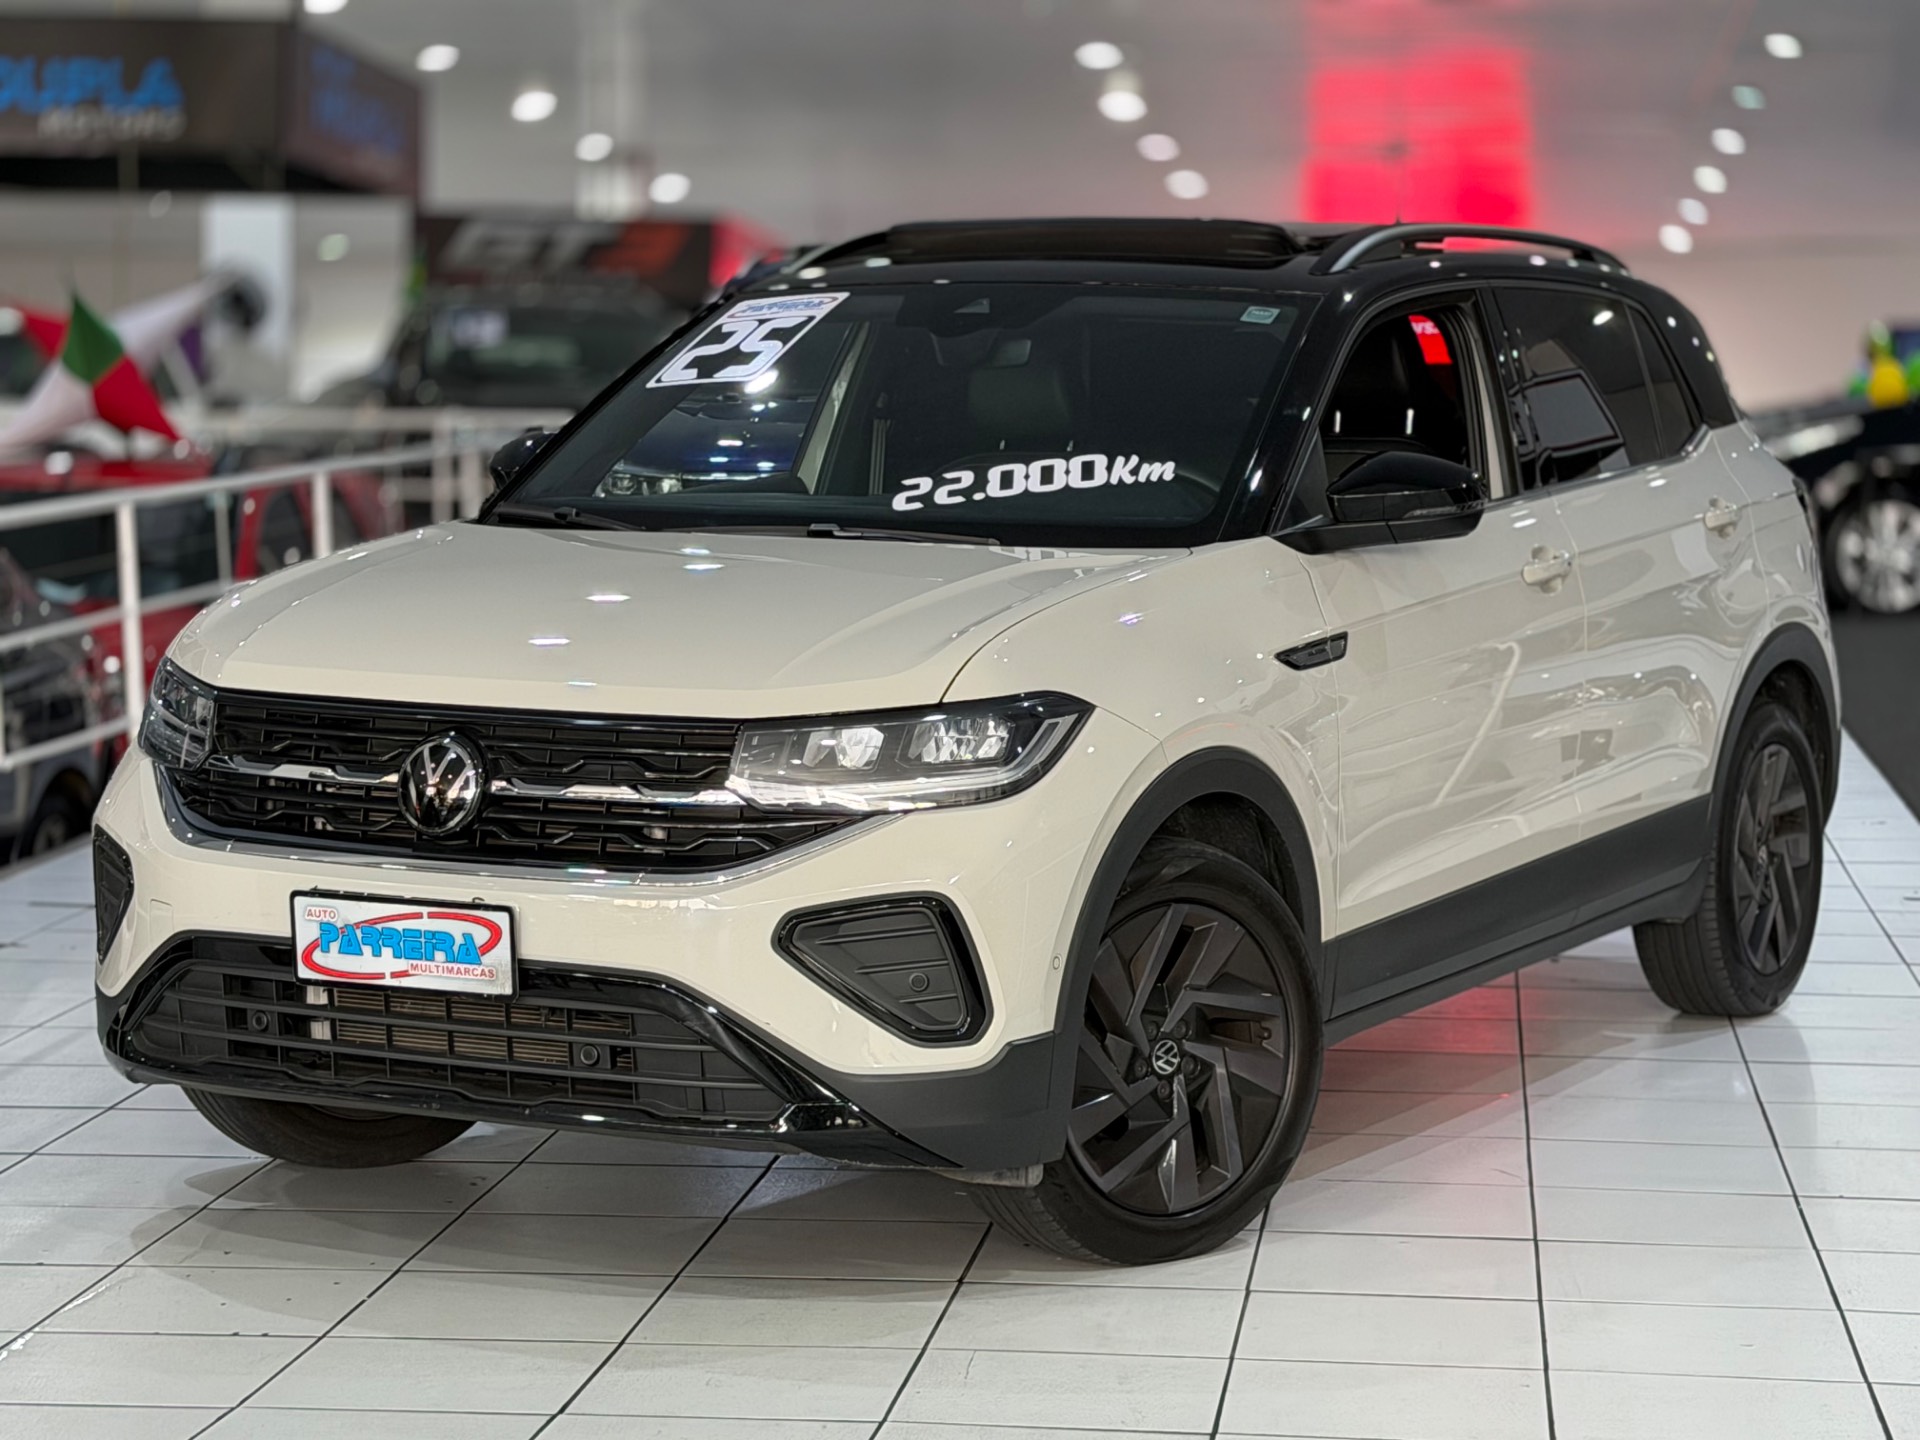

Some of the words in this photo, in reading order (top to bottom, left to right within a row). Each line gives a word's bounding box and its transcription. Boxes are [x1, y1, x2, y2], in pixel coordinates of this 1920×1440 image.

[660, 316, 809, 382] 25
[306, 907, 337, 920] AUTO
[319, 922, 482, 965] PARREIRA
[409, 962, 496, 979] MULTIMARCAS
